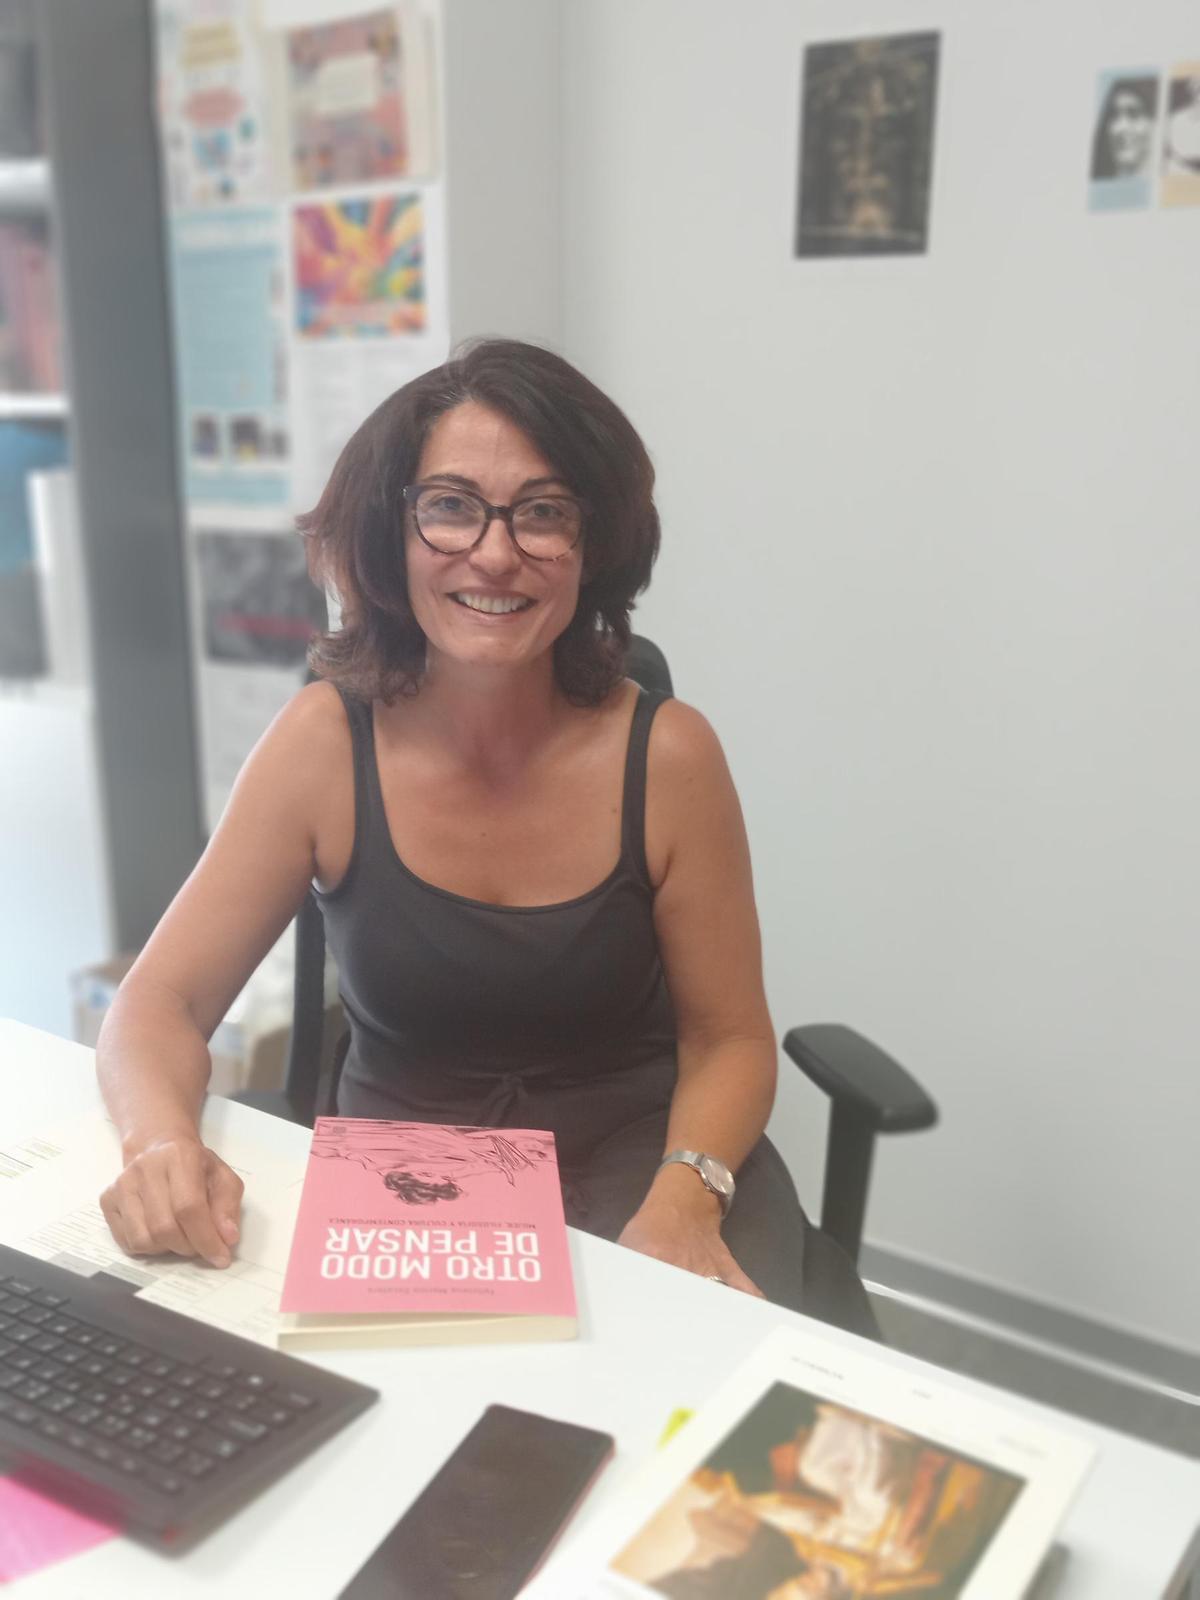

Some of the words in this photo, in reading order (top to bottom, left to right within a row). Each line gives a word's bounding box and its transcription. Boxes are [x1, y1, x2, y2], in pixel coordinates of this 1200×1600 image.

[325, 1227, 478, 1254] PENSAR
[493, 1230, 540, 1256] DE
[320, 1254, 430, 1280] MODO
[446, 1255, 542, 1282] OTRO
